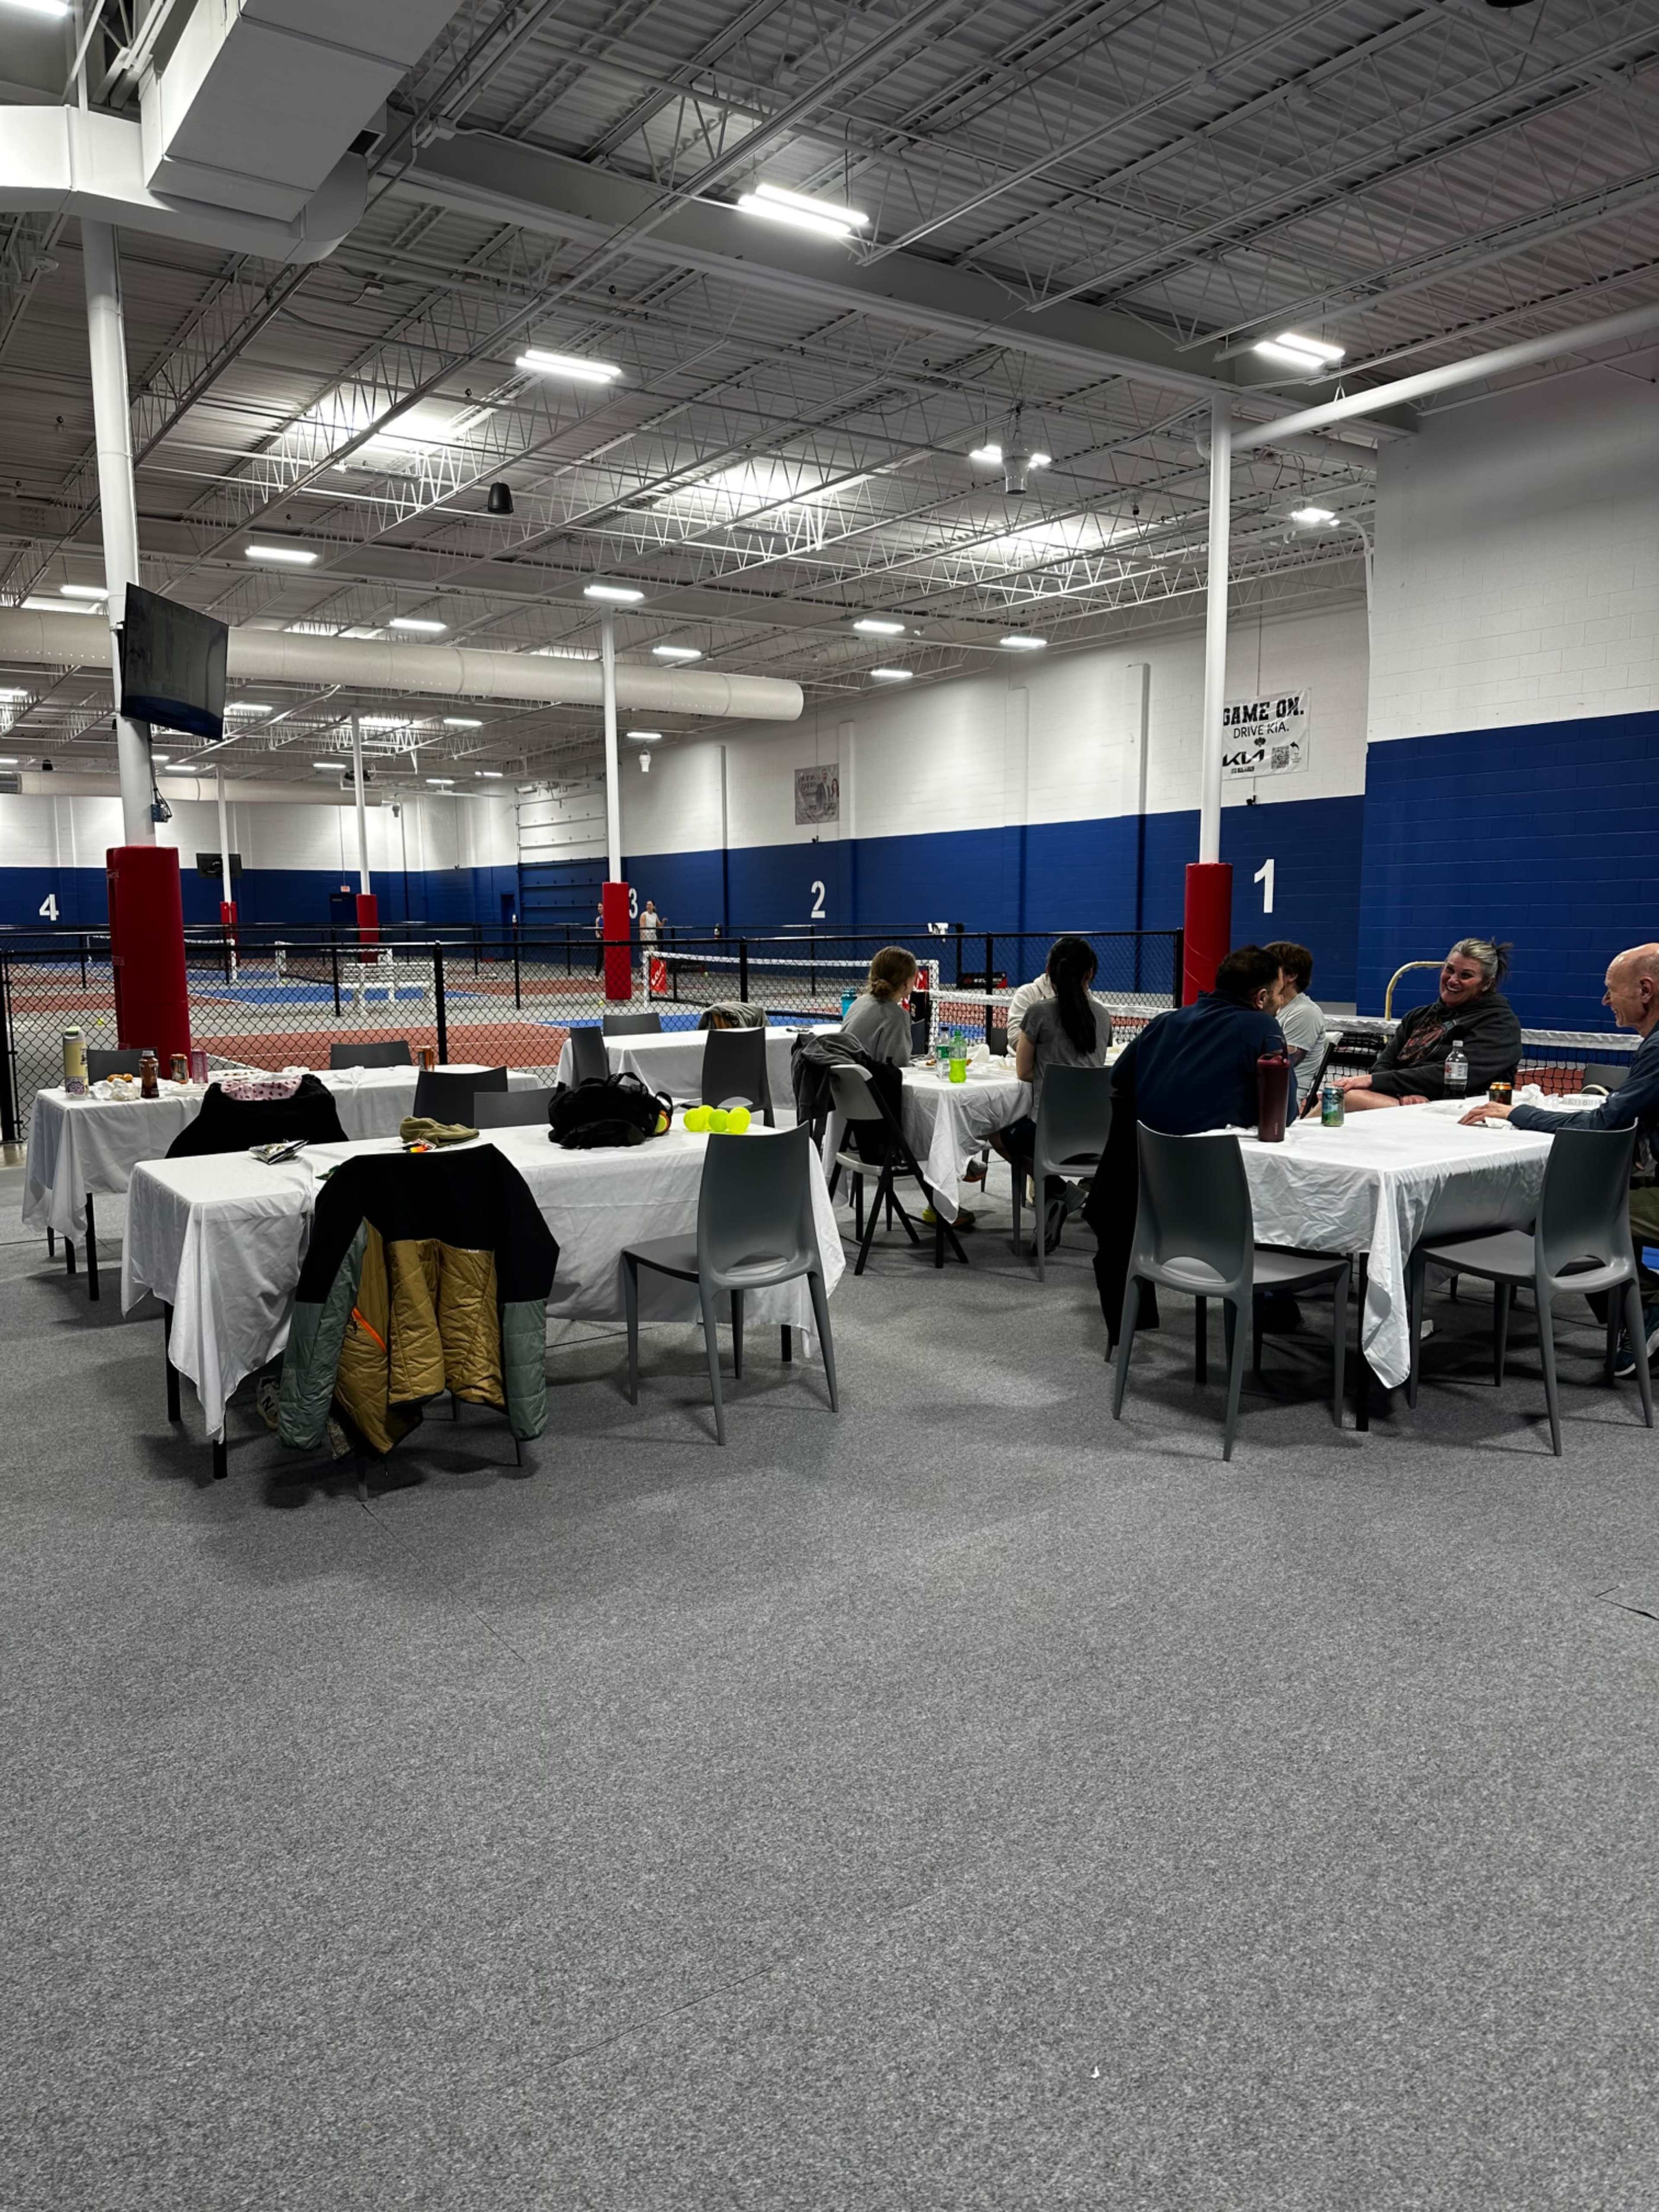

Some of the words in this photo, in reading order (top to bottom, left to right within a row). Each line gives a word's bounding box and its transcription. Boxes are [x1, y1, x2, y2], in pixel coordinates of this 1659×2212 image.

[1224, 702, 1270, 726] GAME
[1234, 725, 1264, 739] DRIVE
[811, 881, 825, 918] 2
[1254, 858, 1274, 913] 1
[39, 894, 59, 921] 4
[629, 888, 638, 918] 3
